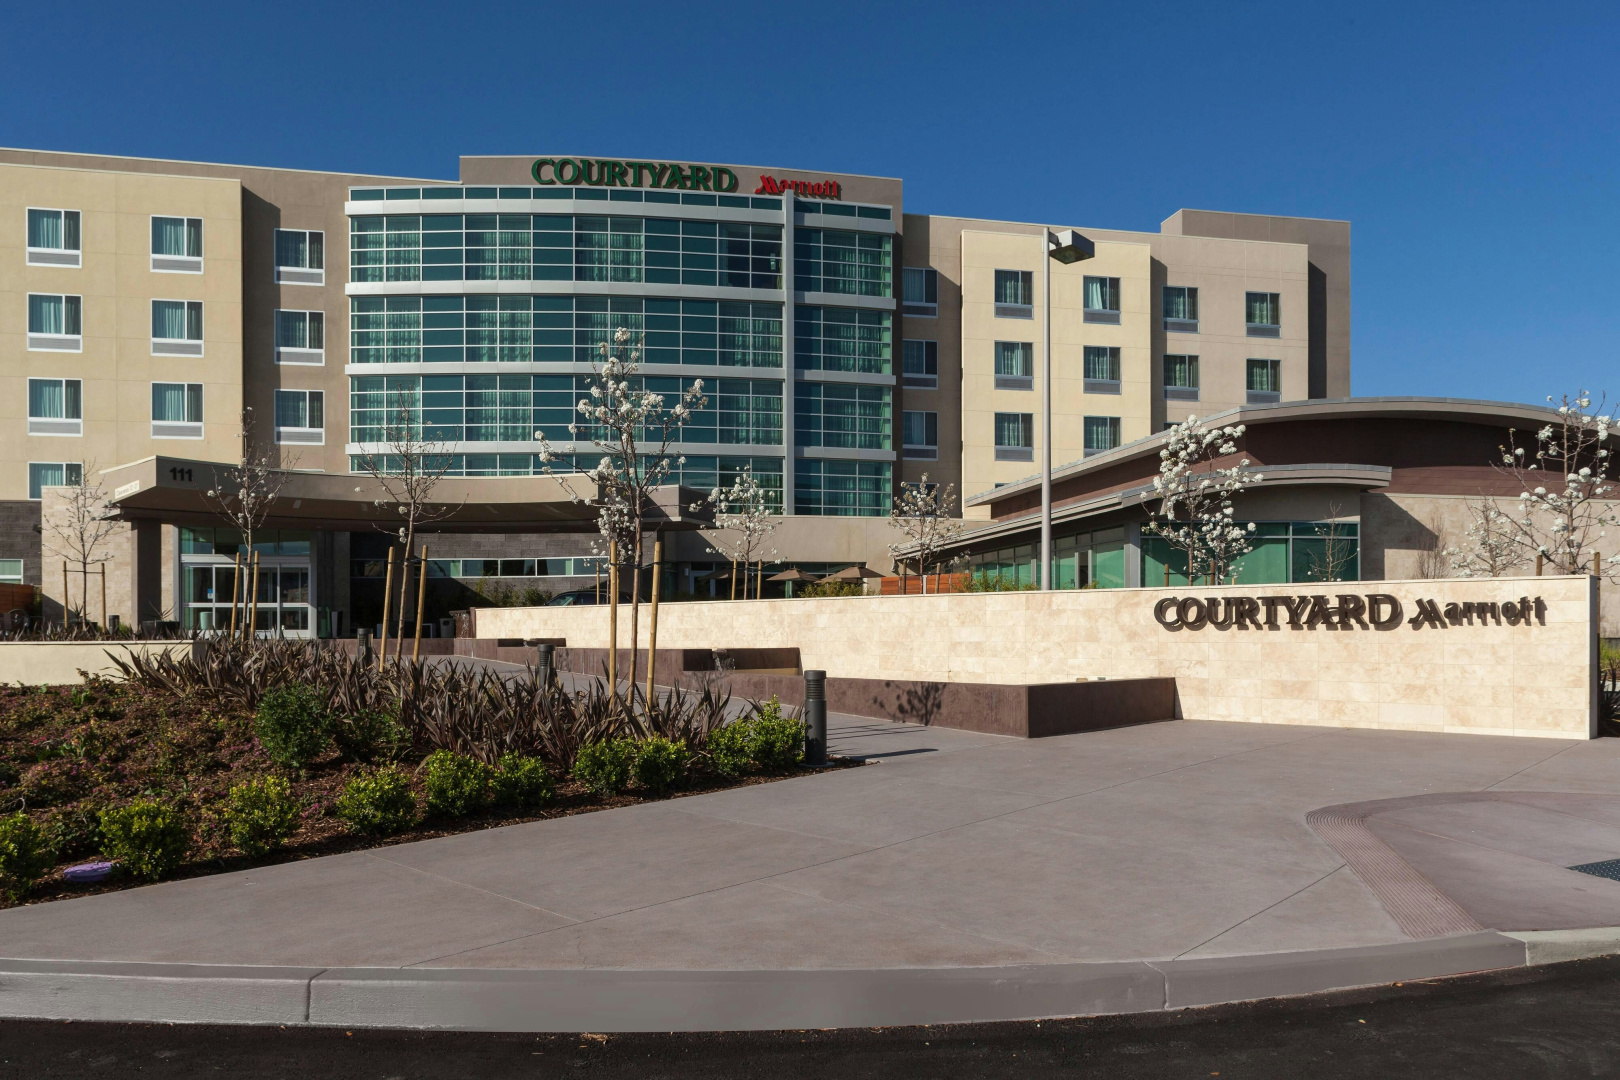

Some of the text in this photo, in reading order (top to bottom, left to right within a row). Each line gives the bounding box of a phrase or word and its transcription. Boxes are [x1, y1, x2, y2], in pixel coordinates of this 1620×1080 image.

[531, 158, 838, 197] COURTYARD Marriott
[169, 466, 193, 482] 111
[1153, 594, 1545, 627] COURTYARD Marriott
